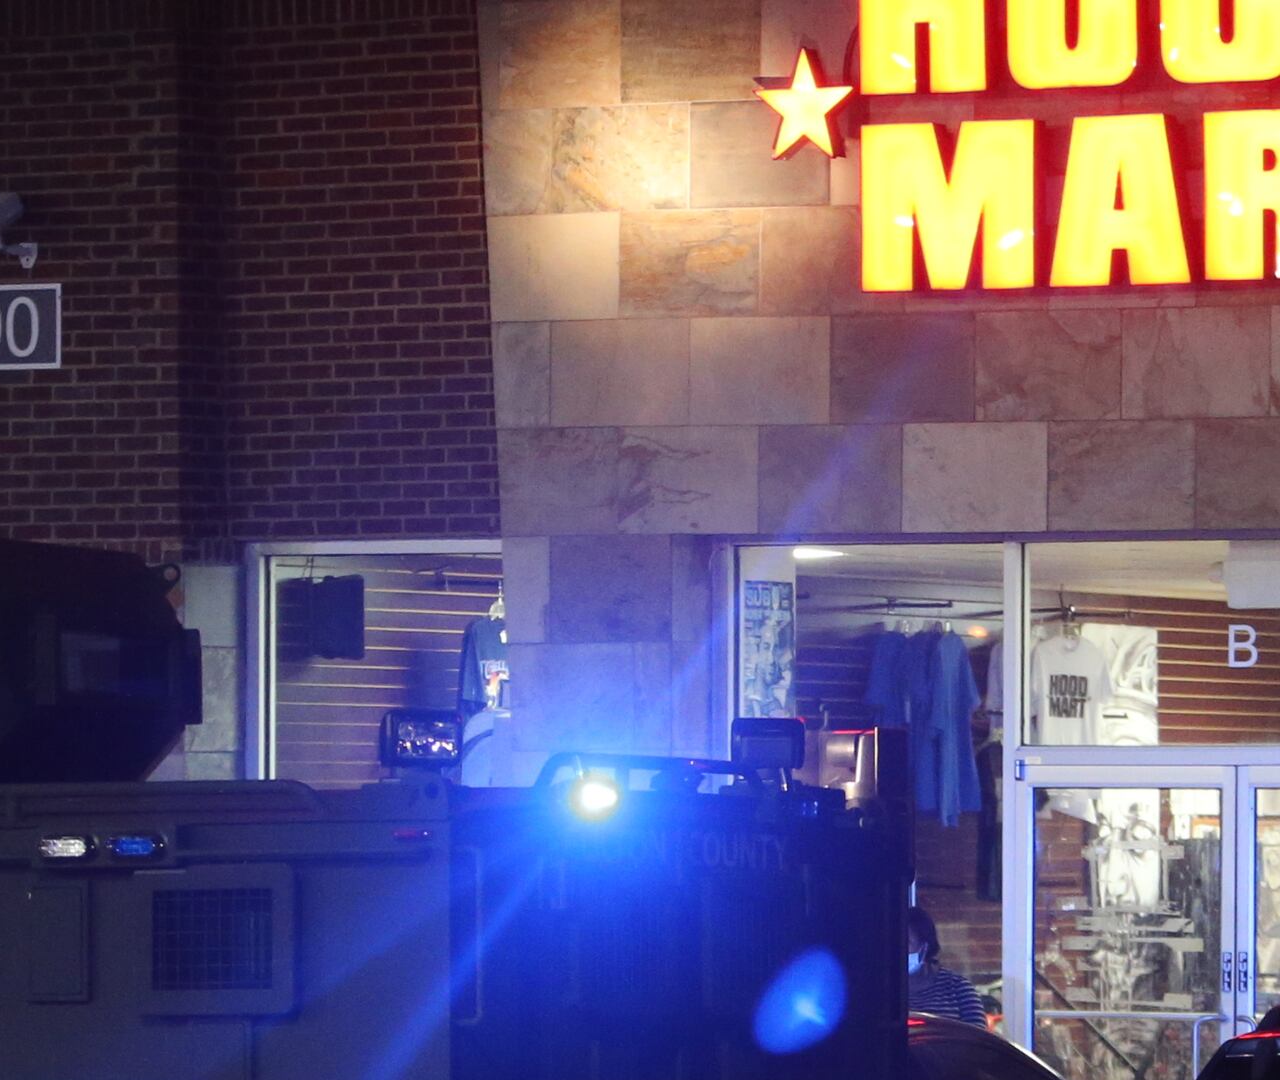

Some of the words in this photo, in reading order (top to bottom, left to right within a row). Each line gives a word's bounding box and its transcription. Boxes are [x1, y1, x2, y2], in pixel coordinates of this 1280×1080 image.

[1228, 624, 1259, 668] B
[1049, 674, 1088, 696] HOOD
[1049, 697, 1086, 718] MART
[1223, 952, 1232, 992] PULL
[1239, 952, 1248, 992] PULL
